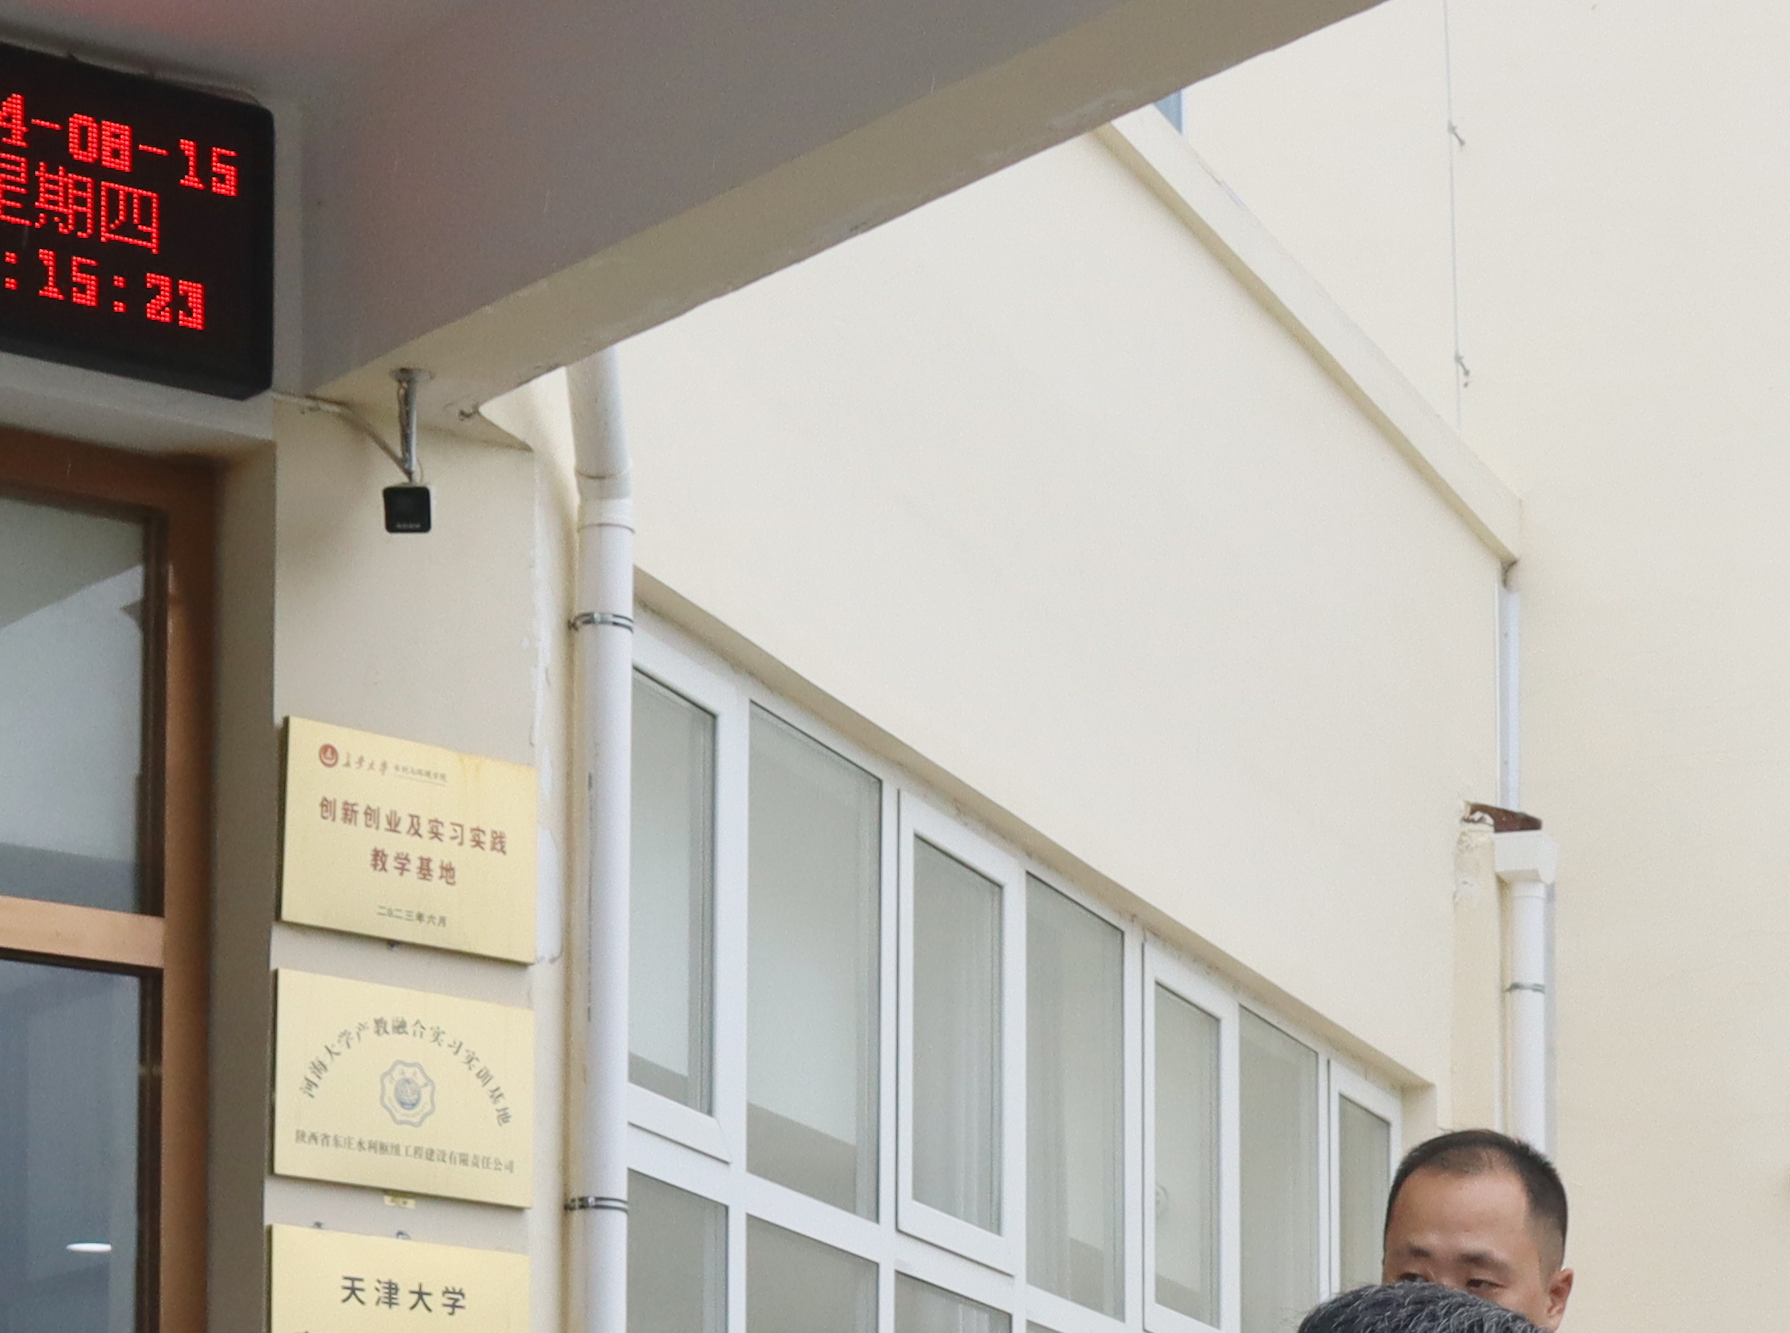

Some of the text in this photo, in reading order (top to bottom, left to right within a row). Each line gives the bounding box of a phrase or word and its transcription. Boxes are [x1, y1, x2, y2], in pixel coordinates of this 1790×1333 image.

[319, 796, 507, 855] 创新创业及实习实践
[370, 847, 457, 886] 教学基地
[299, 1016, 513, 1127] 河海大学产教融合实习实训基地
[295, 1128, 515, 1174] 陕西省东庄水利枢纽工程建设有限责任公司
[341, 1275, 466, 1316] 天津大学
